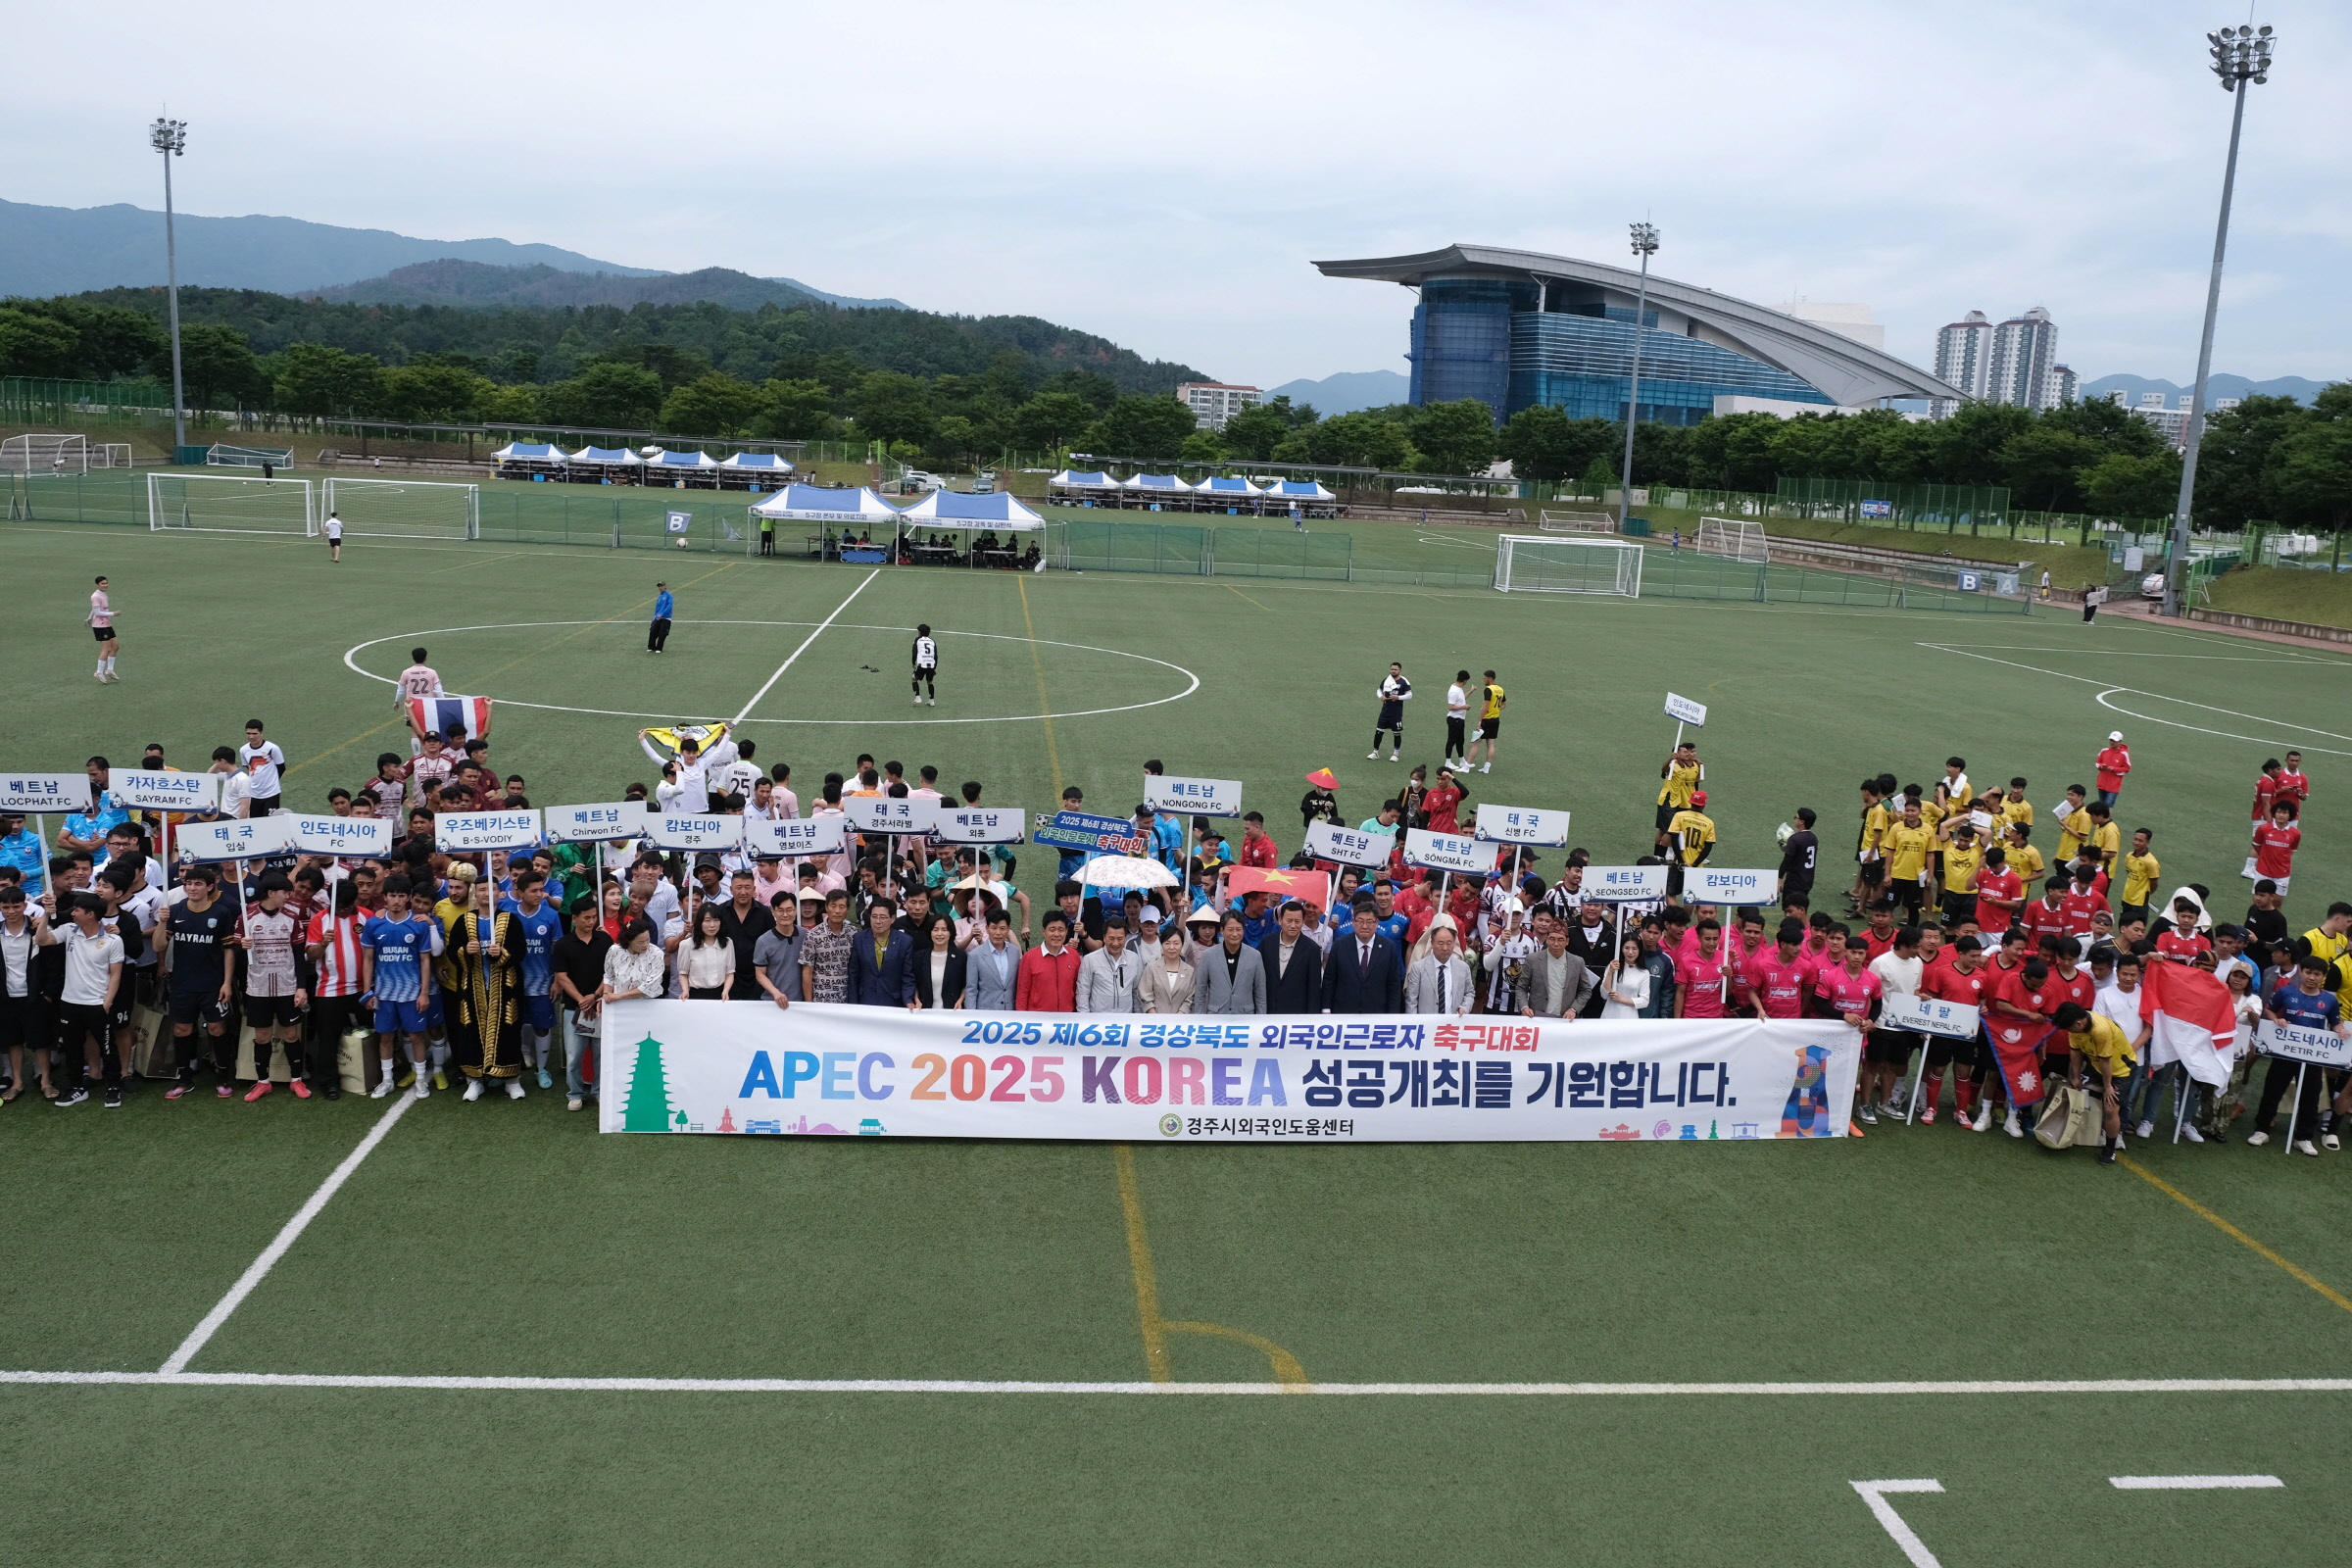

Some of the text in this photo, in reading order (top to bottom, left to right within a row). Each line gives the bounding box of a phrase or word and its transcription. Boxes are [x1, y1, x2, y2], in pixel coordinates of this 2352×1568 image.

[669, 515, 684, 531] B
[1963, 575, 1977, 590] B
[2004, 578, 2014, 593] A
[924, 643, 931, 655] 5
[411, 678, 428, 695] 22
[1673, 698, 1700, 715] 인도네시아
[10, 780, 59, 795] 베트남
[126, 775, 200, 793] 카자흐스탄
[1172, 783, 1215, 799] 베트남
[1, 797, 72, 807] LOCPHAT FC
[135, 794, 192, 806] SAYRAM FC
[1162, 799, 1222, 810] NONGONG FC
[445, 815, 531, 831] 우즈베키스탄
[574, 808, 619, 824] 베트남
[956, 813, 999, 827] 베트남
[300, 820, 376, 839] 인도네시아
[611, 825, 623, 834] FC
[664, 817, 721, 834] 캄보디아
[774, 823, 817, 838] 베트남
[1059, 815, 1128, 833] 2025 제6회 경상북도
[684, 835, 702, 845] 경주
[1039, 826, 1144, 853] 외국인근로자 축구대회
[1522, 828, 1536, 838] FC
[1685, 826, 1701, 849] 10
[330, 839, 345, 848] FC
[1331, 832, 1369, 851] 베트남
[1432, 838, 1473, 856] 베트남
[1331, 848, 1362, 860] SHT FC
[1804, 846, 1815, 869] 3
[1462, 859, 1475, 868] FC
[1606, 871, 1644, 884] 베트남
[1706, 874, 1757, 888] 캄보디아
[1595, 888, 1640, 897] SEONGSEO
[1724, 889, 1737, 898] FT
[174, 932, 214, 944] SAYRAM
[382, 946, 410, 955] BUSAN
[1694, 967, 1700, 976] 7
[1769, 972, 1778, 982] 77
[1838, 985, 1846, 995] 14
[1902, 1015, 1931, 1027] EVEREST
[1932, 1020, 1951, 1031] NEPAL
[961, 1020, 1541, 1053] 2025 제6회 경상북도 외국인근로자 축구대회
[2275, 1028, 2344, 1052] 인도네시아
[2283, 1045, 2330, 1059] PETIR FC
[738, 1050, 1738, 1109] APEC 2025 KOREA 성공개최를 기원합니다.
[1187, 1117, 1354, 1137] 경주시외국인도움센터
